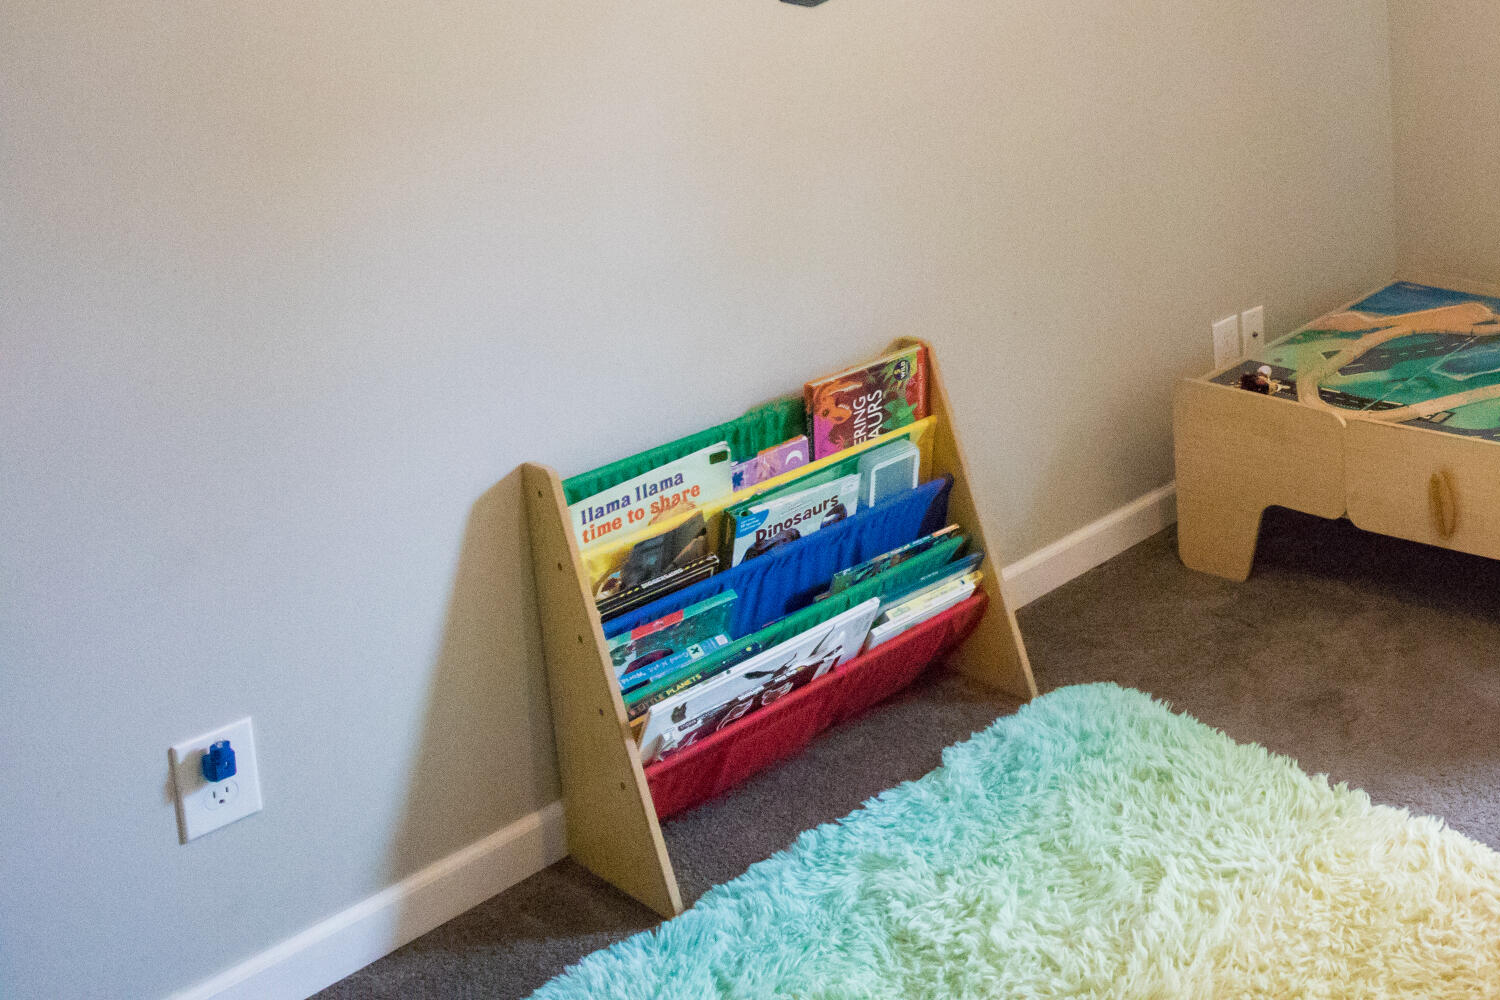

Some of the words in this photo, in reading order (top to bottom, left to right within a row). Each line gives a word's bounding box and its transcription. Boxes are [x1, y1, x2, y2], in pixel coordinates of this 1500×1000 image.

[581, 494, 631, 525] llama
[635, 472, 684, 502] llama
[582, 516, 623, 544] time
[627, 507, 645, 524] to
[650, 484, 701, 515] share
[755, 494, 839, 545] Dinosaurs
[665, 673, 702, 696] PLANETS
